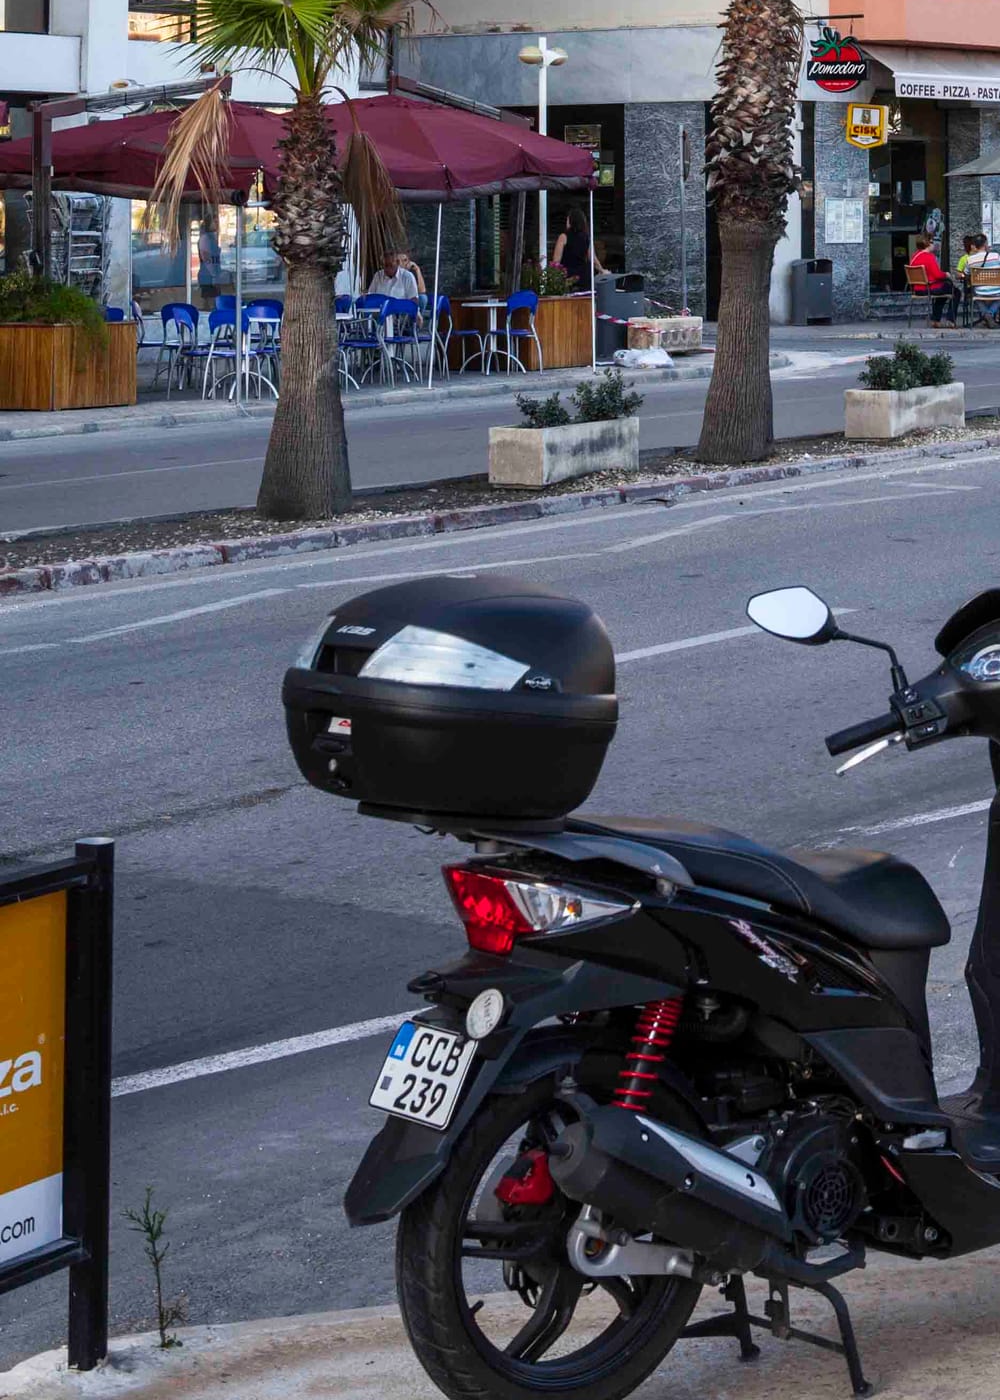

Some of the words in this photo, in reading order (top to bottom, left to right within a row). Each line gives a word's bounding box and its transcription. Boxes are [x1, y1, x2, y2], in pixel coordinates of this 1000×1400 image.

[900, 83, 936, 97] COFFEE
[943, 85, 970, 98] PIZZA
[410, 1032, 465, 1078] CCB
[393, 1074, 448, 1118] 239
